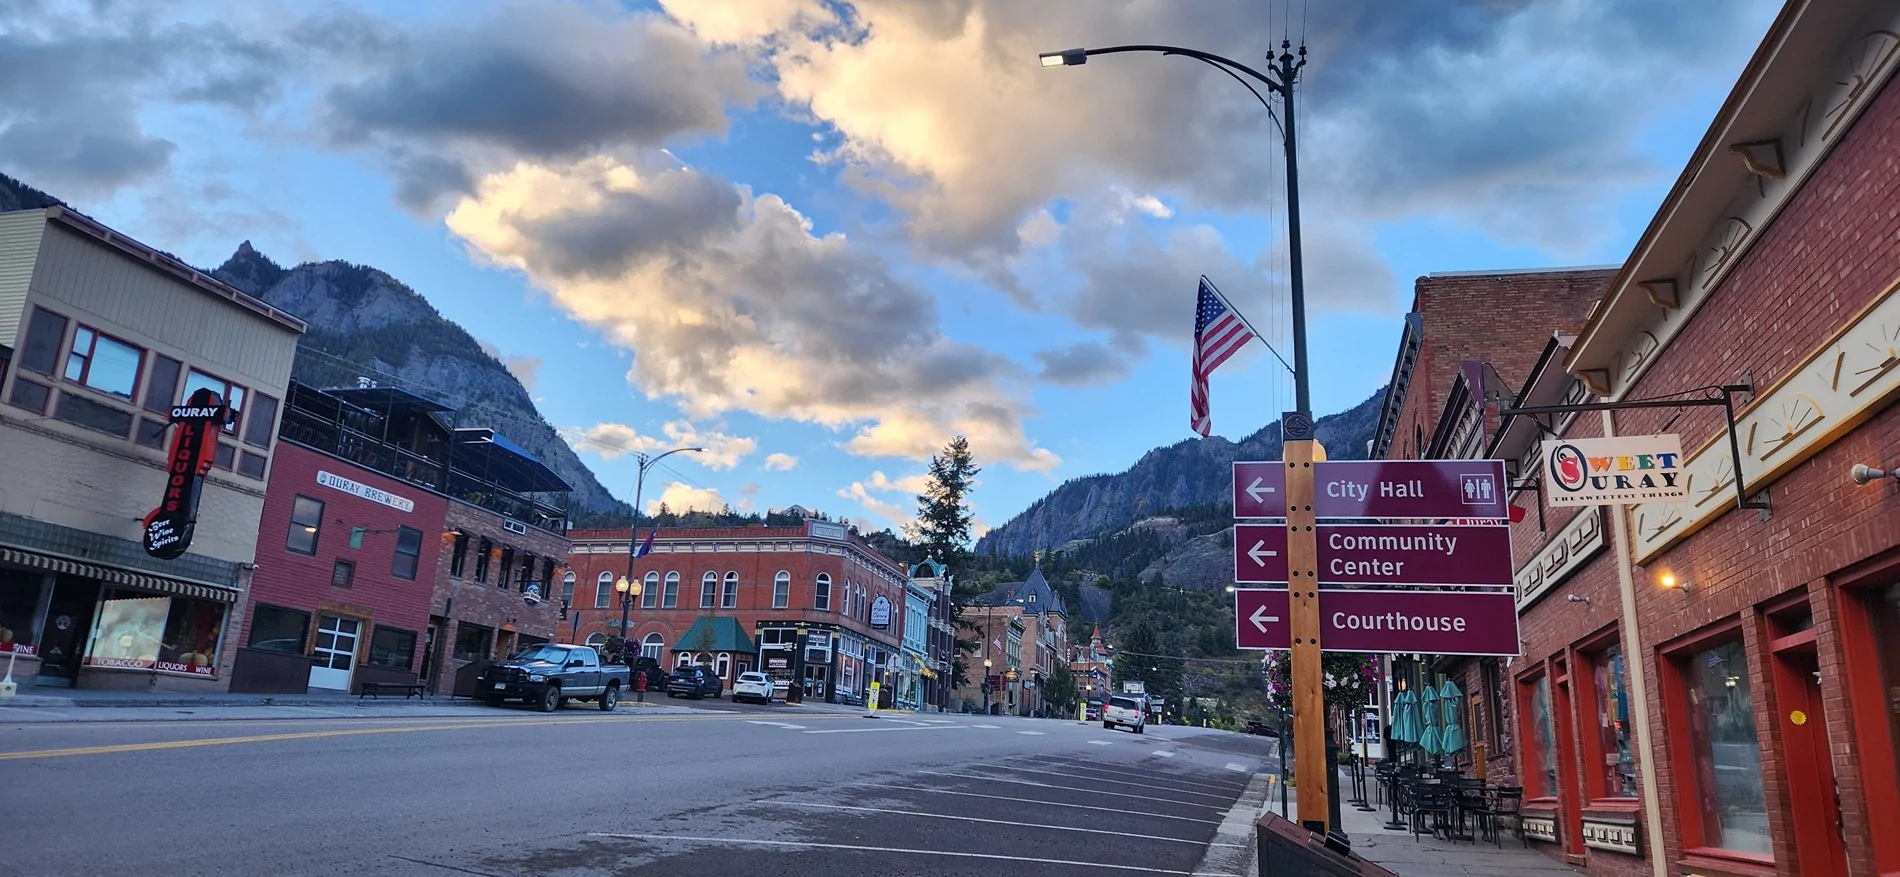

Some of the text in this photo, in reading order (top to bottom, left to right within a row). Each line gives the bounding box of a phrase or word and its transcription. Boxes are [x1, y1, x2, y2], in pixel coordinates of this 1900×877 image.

[171, 407, 219, 417] OURAY
[166, 425, 194, 512] LIQUORS
[1550, 444, 1679, 492] OURAY
[1560, 452, 1679, 484] SWEET
[328, 475, 410, 511] OURAY BREWERY
[1326, 479, 1424, 502] City Hall
[1580, 493, 1637, 501] SWEETEST
[148, 519, 170, 532] Beer
[148, 528, 174, 542] Wine
[148, 535, 179, 551] Spirits
[1329, 532, 1458, 556] Community
[1330, 558, 1404, 576] Center
[1332, 612, 1466, 632] Courthouse
[96, 657, 143, 668] TOBACCO
[158, 661, 213, 675] LIQUORS WINE
